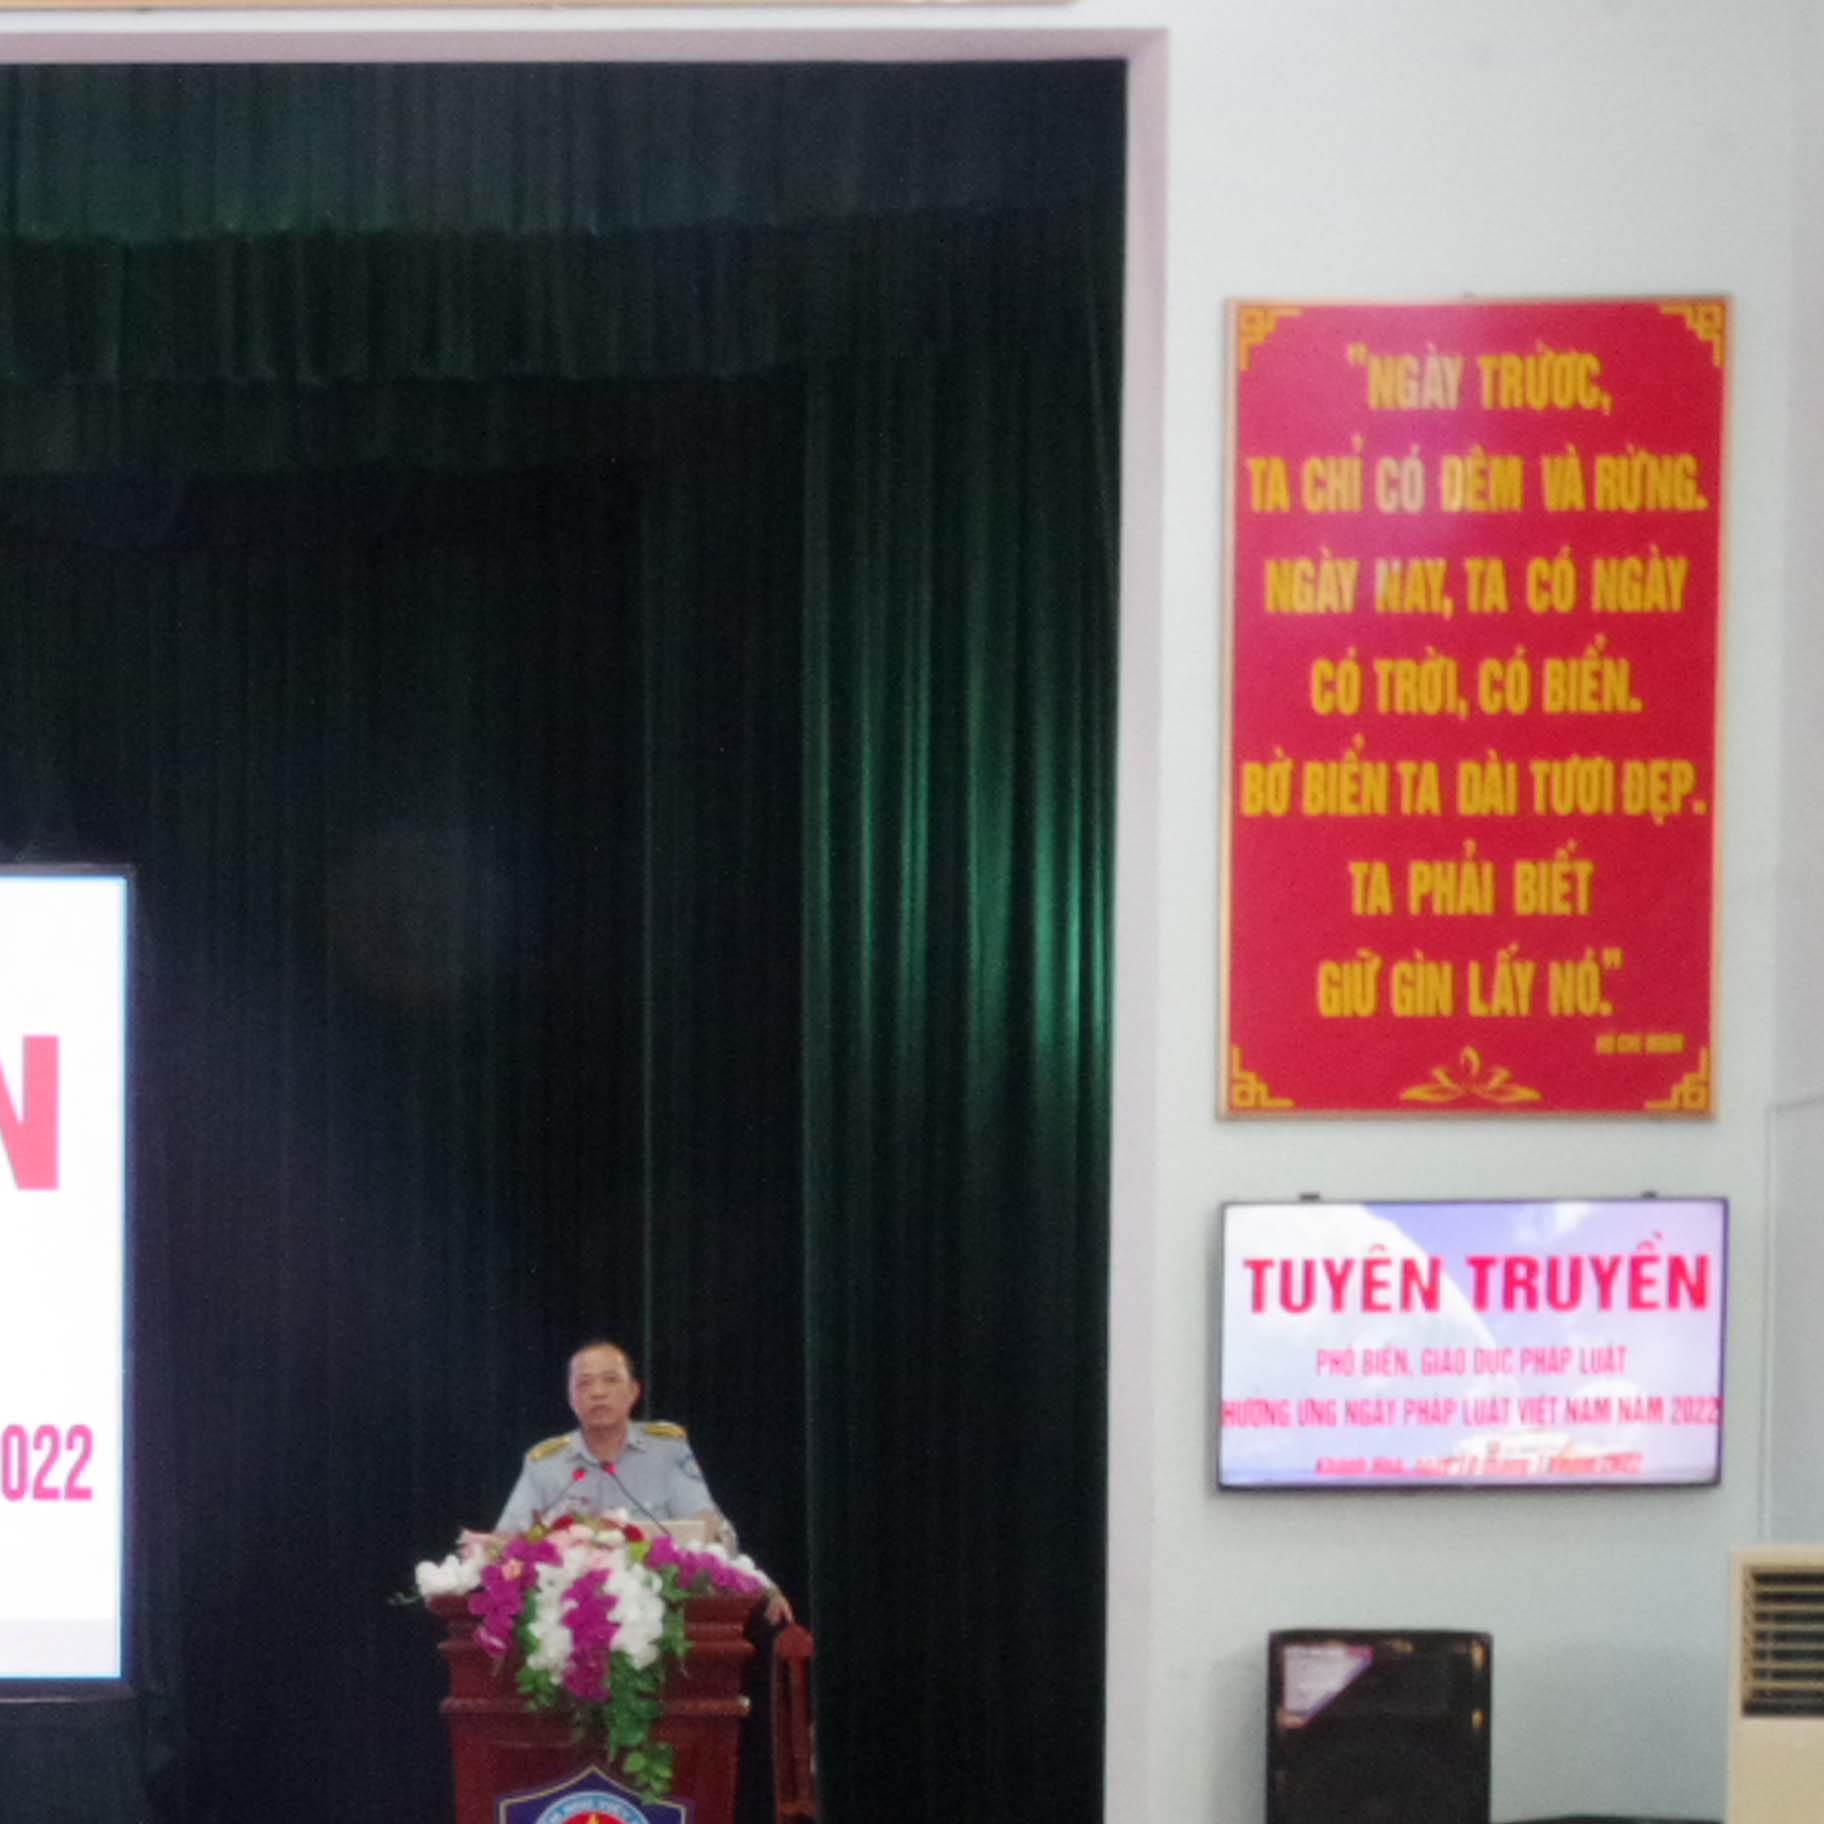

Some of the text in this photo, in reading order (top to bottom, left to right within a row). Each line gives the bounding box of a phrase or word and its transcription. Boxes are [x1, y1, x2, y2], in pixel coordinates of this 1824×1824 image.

[1248, 457, 1290, 511] TA
[1464, 557, 1508, 613] TA
[1397, 760, 1441, 815] TA
[1349, 861, 1393, 916] TA
[1243, 1231, 1710, 1313] TUYÊN TRUYỀN
